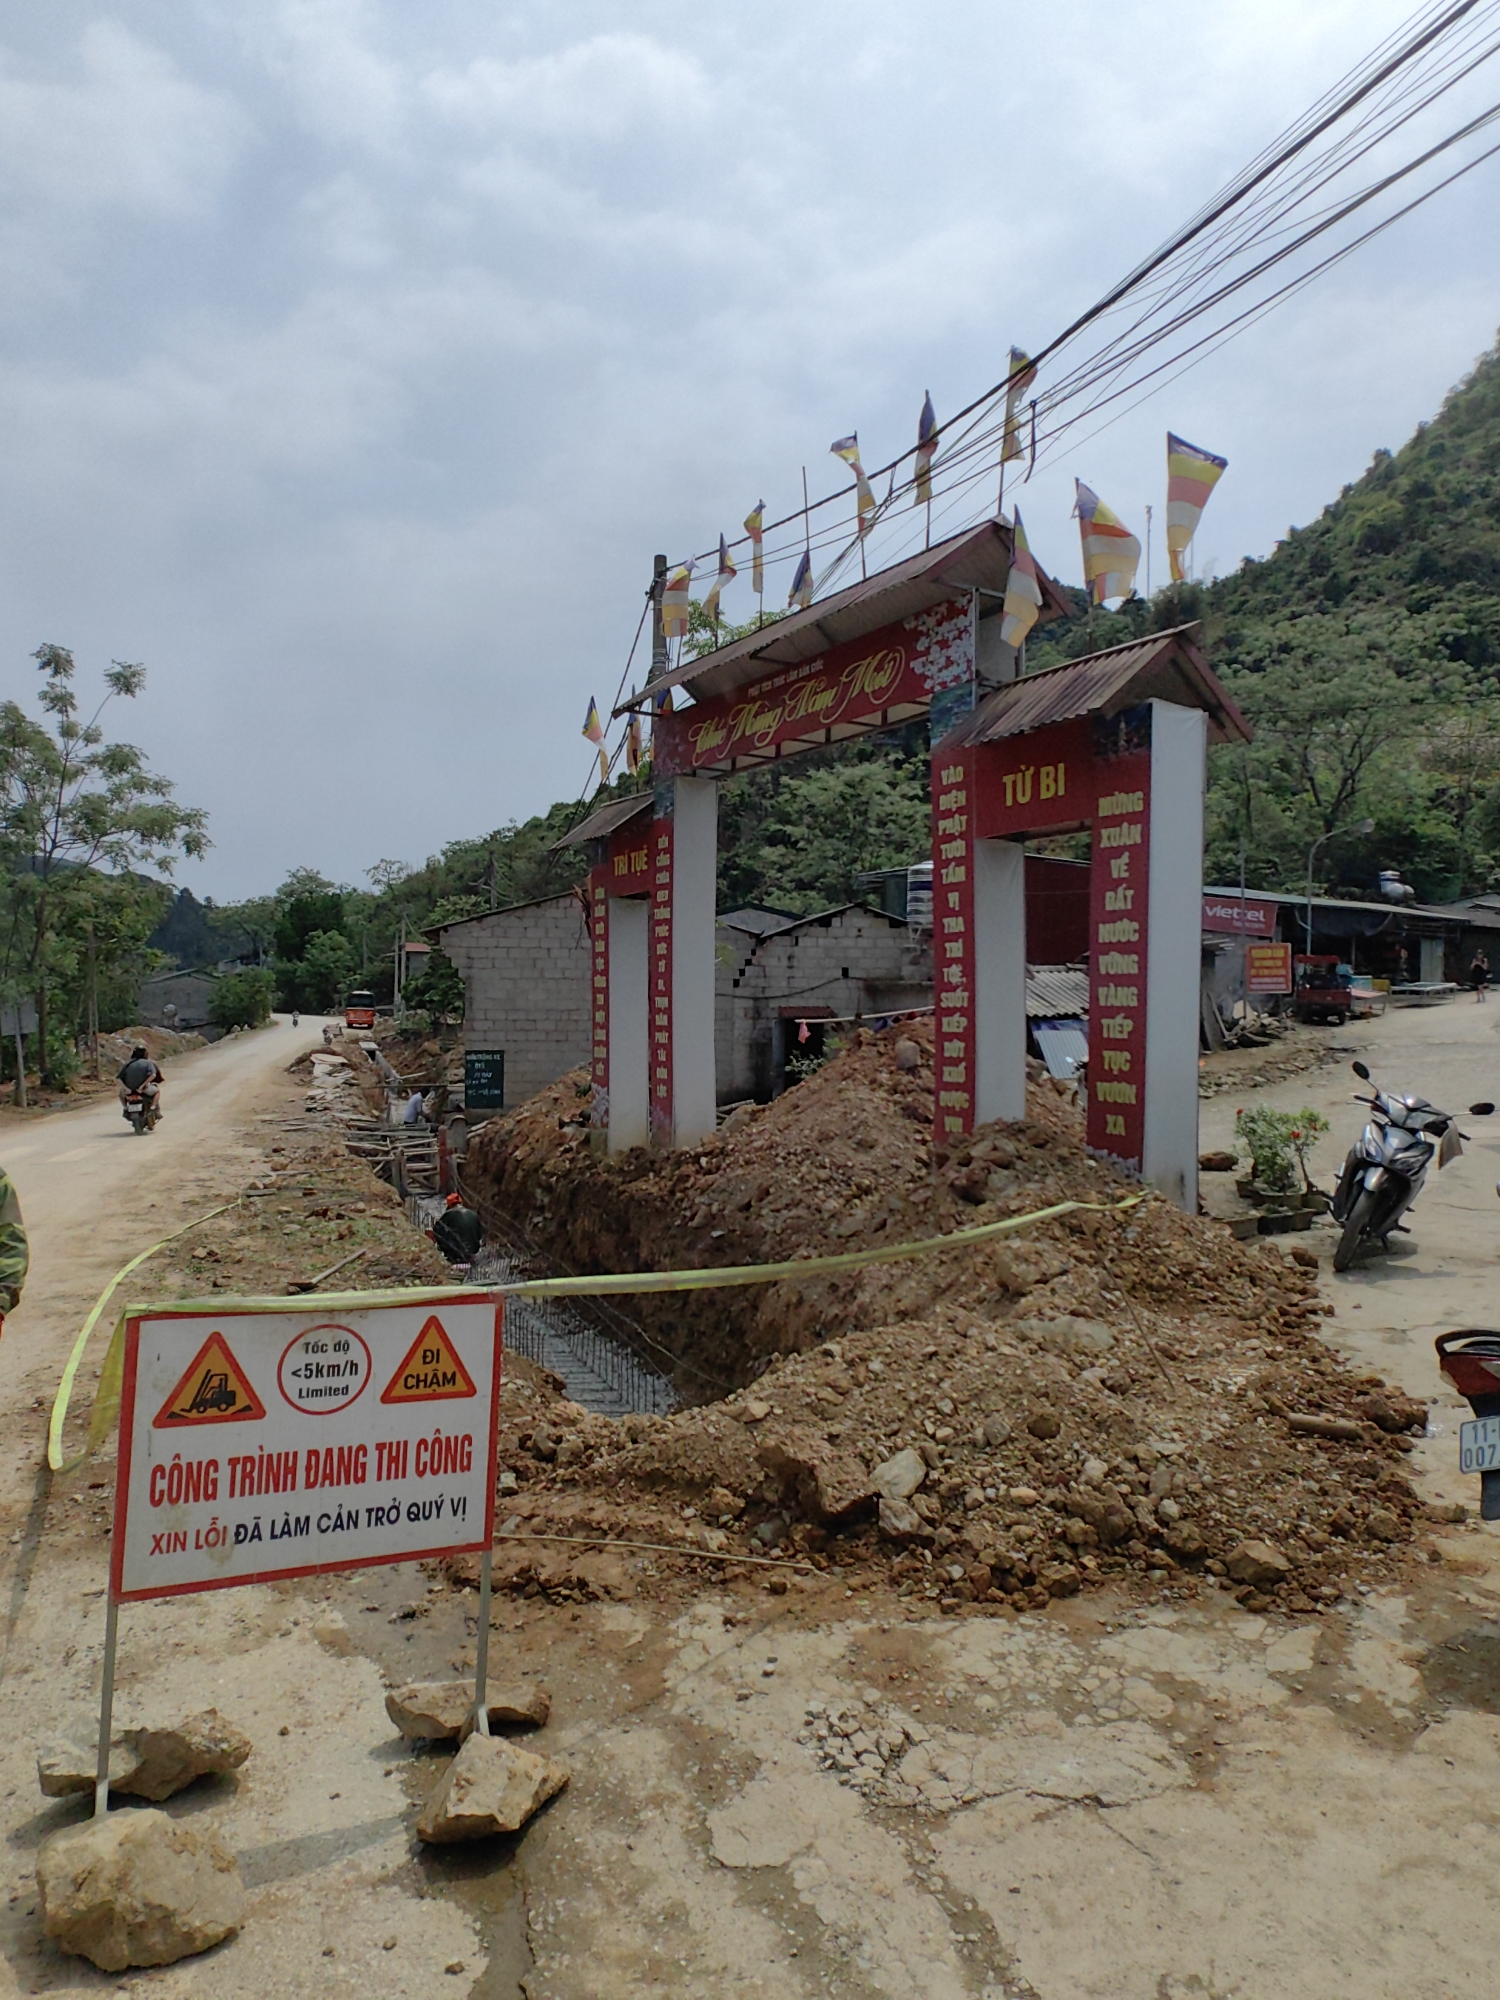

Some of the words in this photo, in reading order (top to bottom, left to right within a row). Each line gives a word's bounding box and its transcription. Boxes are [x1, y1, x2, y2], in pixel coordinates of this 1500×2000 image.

[940, 765, 964, 786] VÀO
[1002, 764, 1034, 807] TỪ
[1039, 762, 1066, 800] BI
[1098, 791, 1144, 817] MỪNG
[937, 813, 968, 837] PHẬT
[1099, 821, 1142, 848] XUÂN
[1098, 918, 1140, 943] NƯỚC
[1097, 982, 1138, 1007] VÀNG
[1101, 1013, 1134, 1039] TIẾP
[1102, 1050, 1131, 1075] TỤC
[1105, 1114, 1126, 1136] XA
[303, 1339, 328, 1354] Tốc
[422, 1348, 440, 1366] ĐI
[291, 1360, 358, 1380] <5km/h
[404, 1368, 456, 1392] CHẬM
[298, 1384, 349, 1400] Limited
[1472, 1422, 1500, 1444] 11-
[150, 1452, 219, 1508] CÔNG
[228, 1444, 298, 1498] TRÌNH
[304, 1443, 368, 1490] ĐANG
[374, 1440, 408, 1482] THI
[414, 1428, 472, 1478] CÔNG
[149, 1530, 188, 1556] XIN
[194, 1516, 228, 1550] LỖI
[234, 1516, 262, 1545] ĐÃ
[269, 1512, 310, 1540] LÀM
[316, 1503, 360, 1534] CẢN
[366, 1497, 401, 1528] TRỞ
[406, 1494, 444, 1522] QUÝ
[450, 1496, 467, 1522] VỊ
